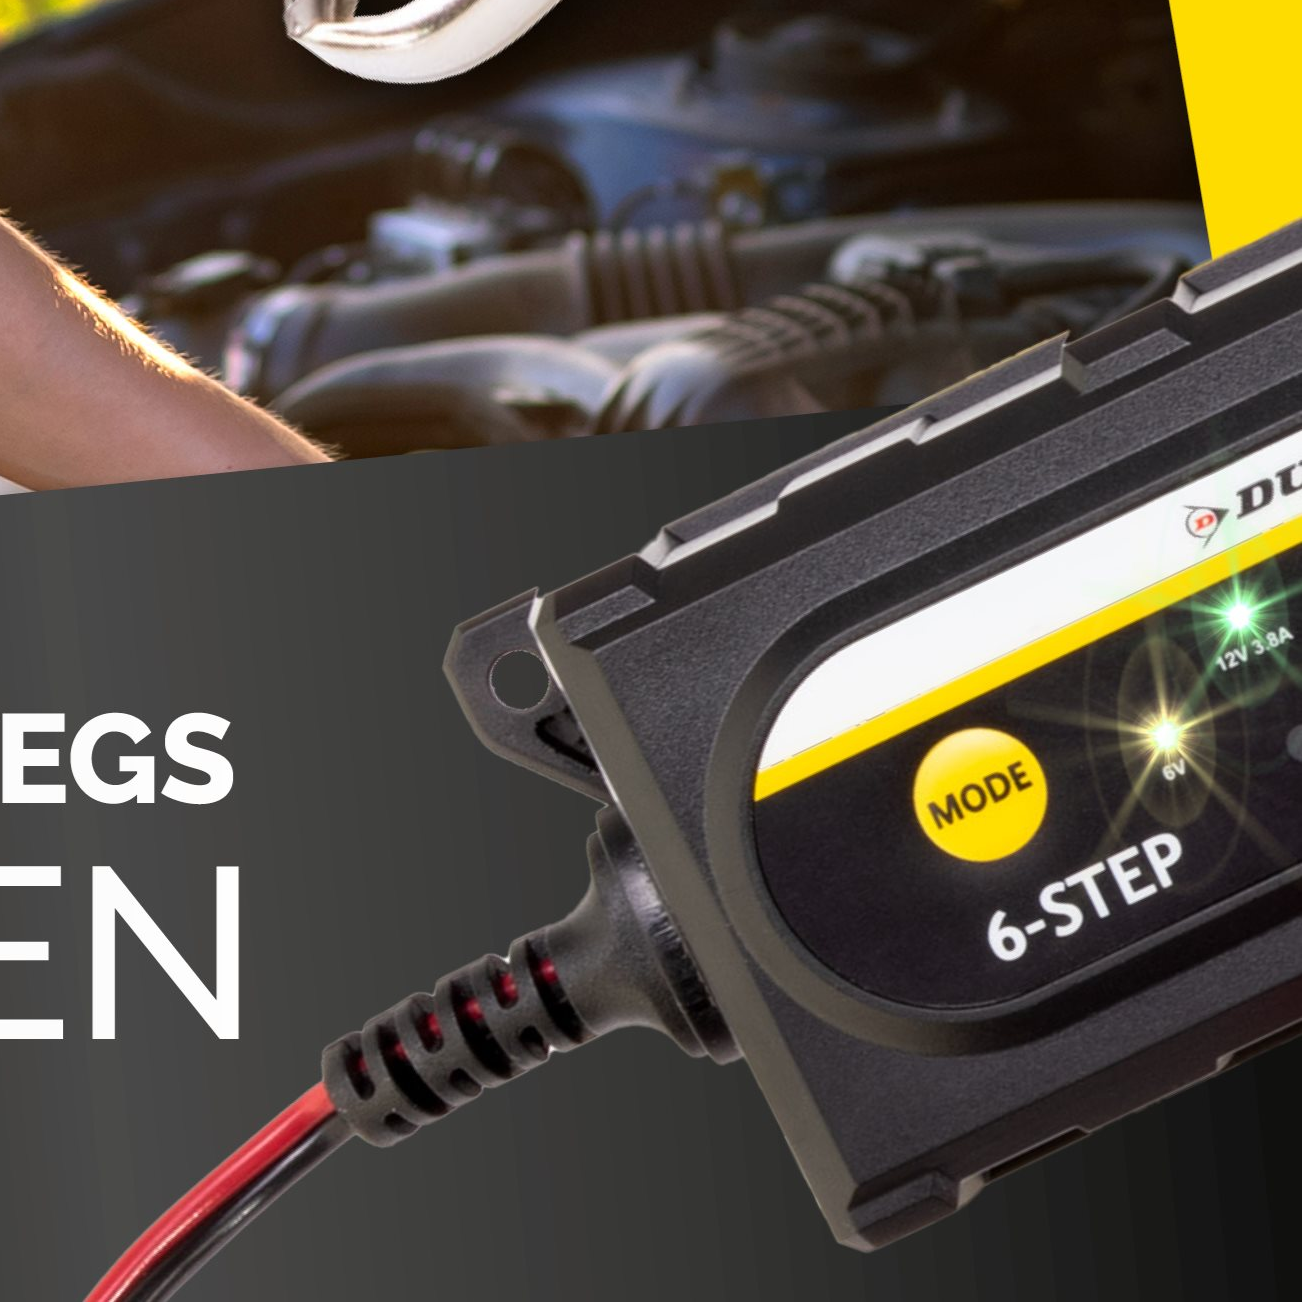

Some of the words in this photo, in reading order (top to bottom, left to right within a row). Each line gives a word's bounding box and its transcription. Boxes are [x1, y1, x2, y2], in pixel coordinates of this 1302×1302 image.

[1216, 645, 1248, 672] 12V
[1251, 626, 1294, 655] 3.8A
[927, 761, 1034, 830] MODE
[1162, 759, 1187, 781] 6V
[987, 832, 1184, 962] 6-STEP
